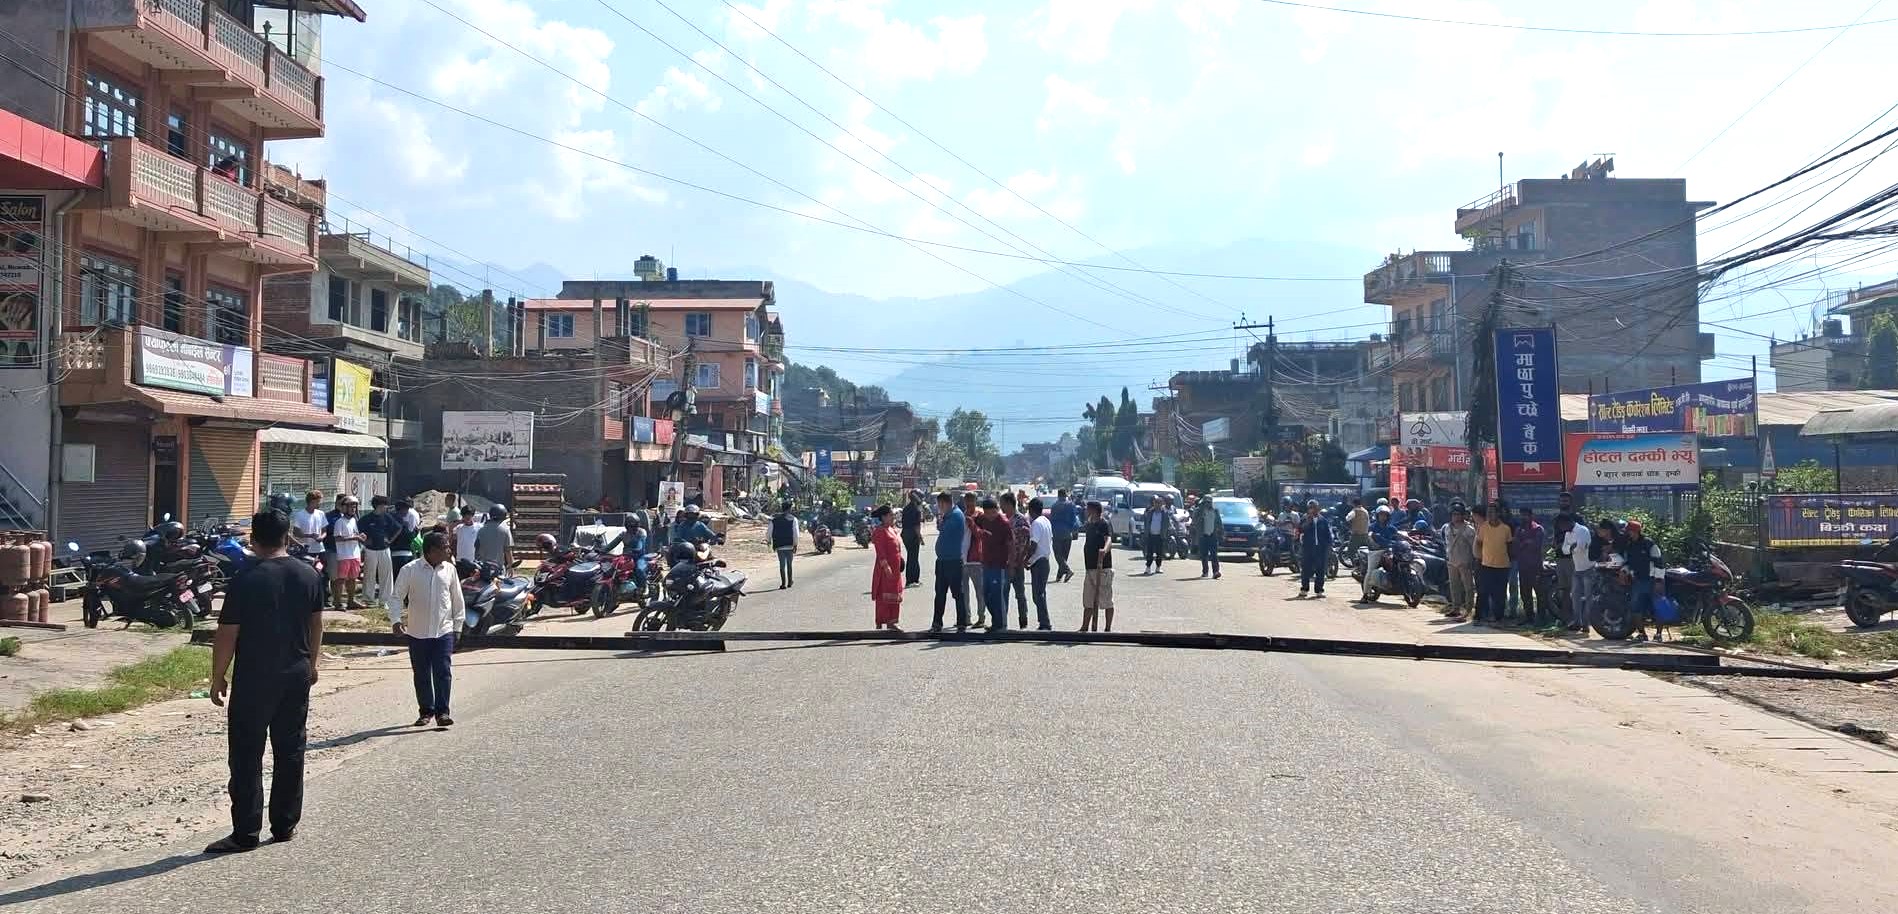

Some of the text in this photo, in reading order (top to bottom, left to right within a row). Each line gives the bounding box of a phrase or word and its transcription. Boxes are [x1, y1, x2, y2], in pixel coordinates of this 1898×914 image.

[0, 202, 36, 218] Salon
[1584, 448, 1696, 464] होटल दम्की भ्यू
